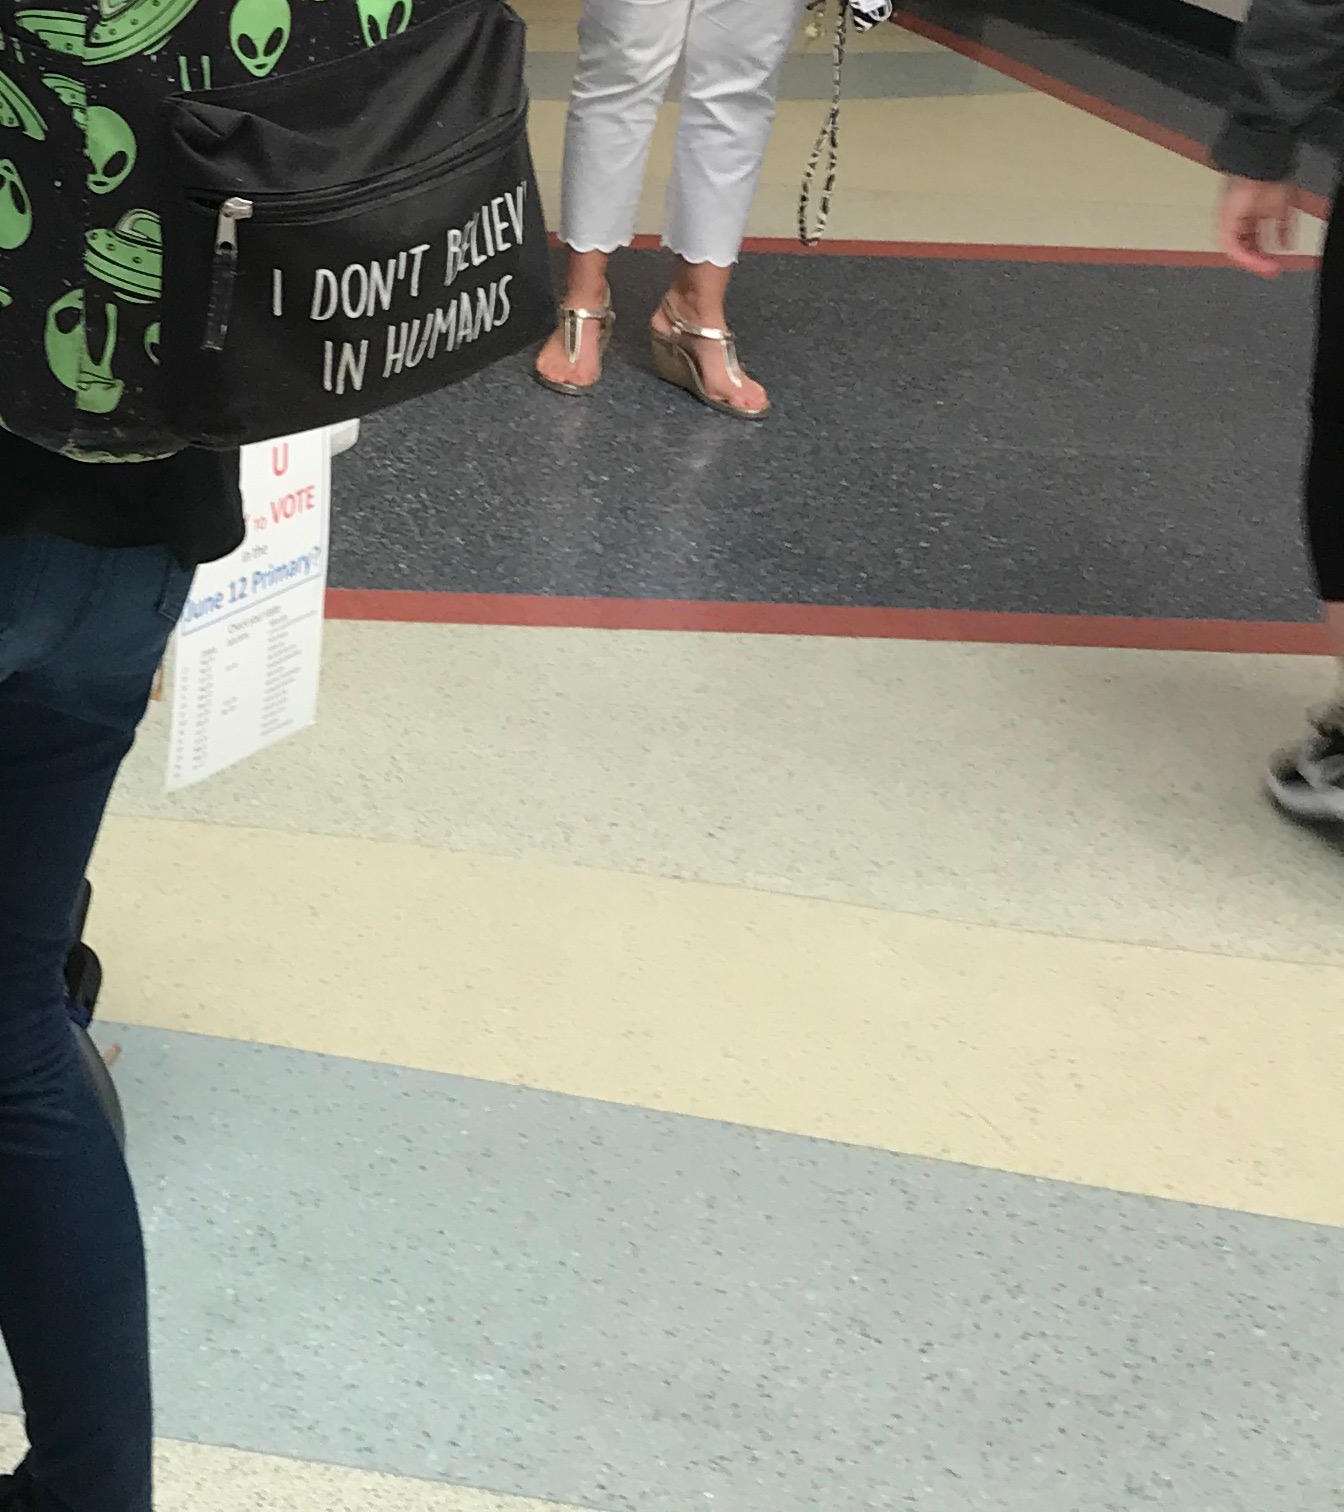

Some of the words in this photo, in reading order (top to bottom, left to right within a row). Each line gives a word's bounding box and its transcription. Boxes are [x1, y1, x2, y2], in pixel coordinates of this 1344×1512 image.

[272, 268, 282, 317] I
[310, 244, 430, 321] DON'T
[444, 180, 527, 286] BELIEV
[323, 339, 369, 395] IN
[382, 274, 513, 378] HUMANS
[272, 441, 289, 477] U
[269, 484, 316, 525] VOTE
[183, 590, 225, 623] June
[228, 575, 248, 604] 12
[251, 545, 322, 594] Primary?
